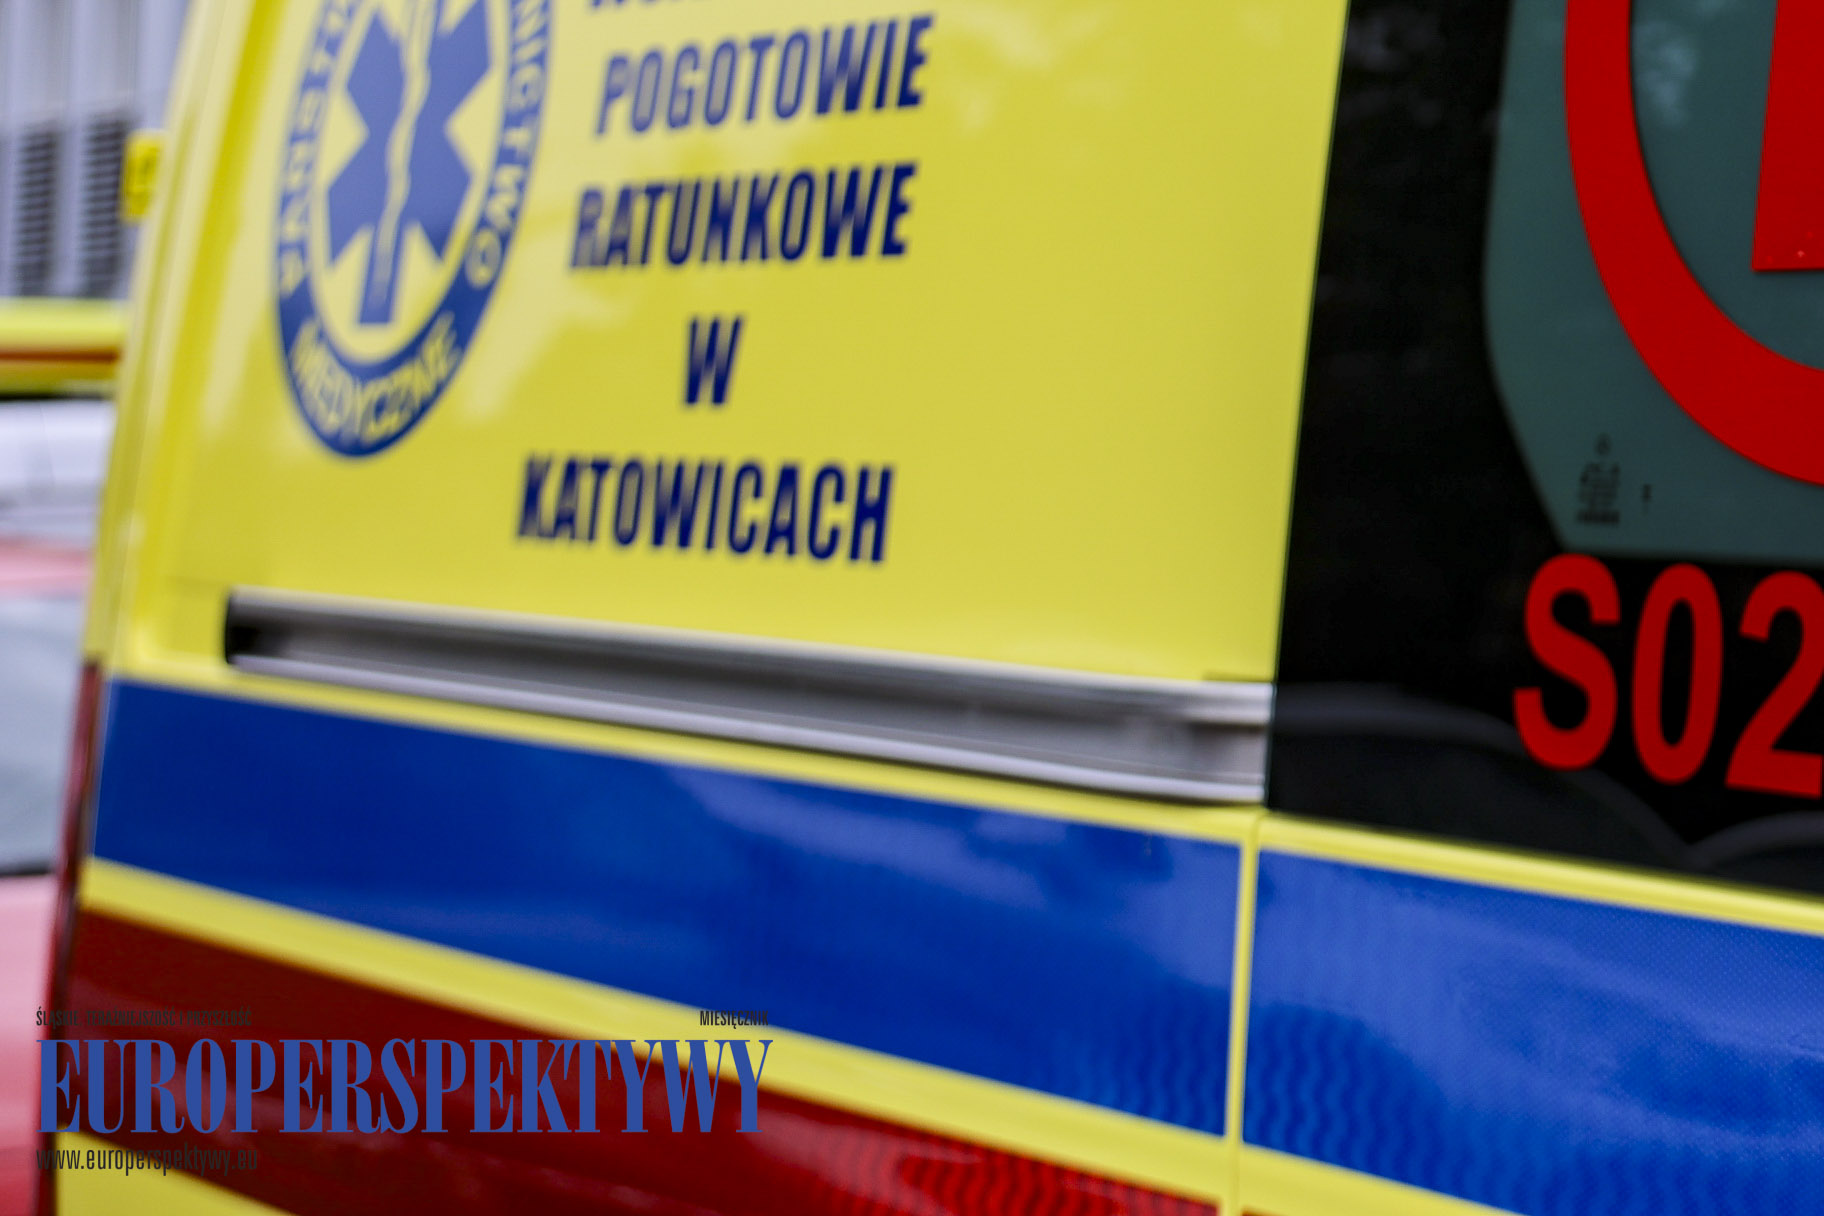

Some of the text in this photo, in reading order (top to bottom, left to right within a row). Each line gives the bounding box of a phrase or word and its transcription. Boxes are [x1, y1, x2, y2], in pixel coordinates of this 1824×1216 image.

[595, 15, 932, 136] POGOTOWIE
[568, 161, 916, 269] RATUNKOWE
[680, 312, 745, 409] W
[515, 451, 895, 564] KATOWICACH
